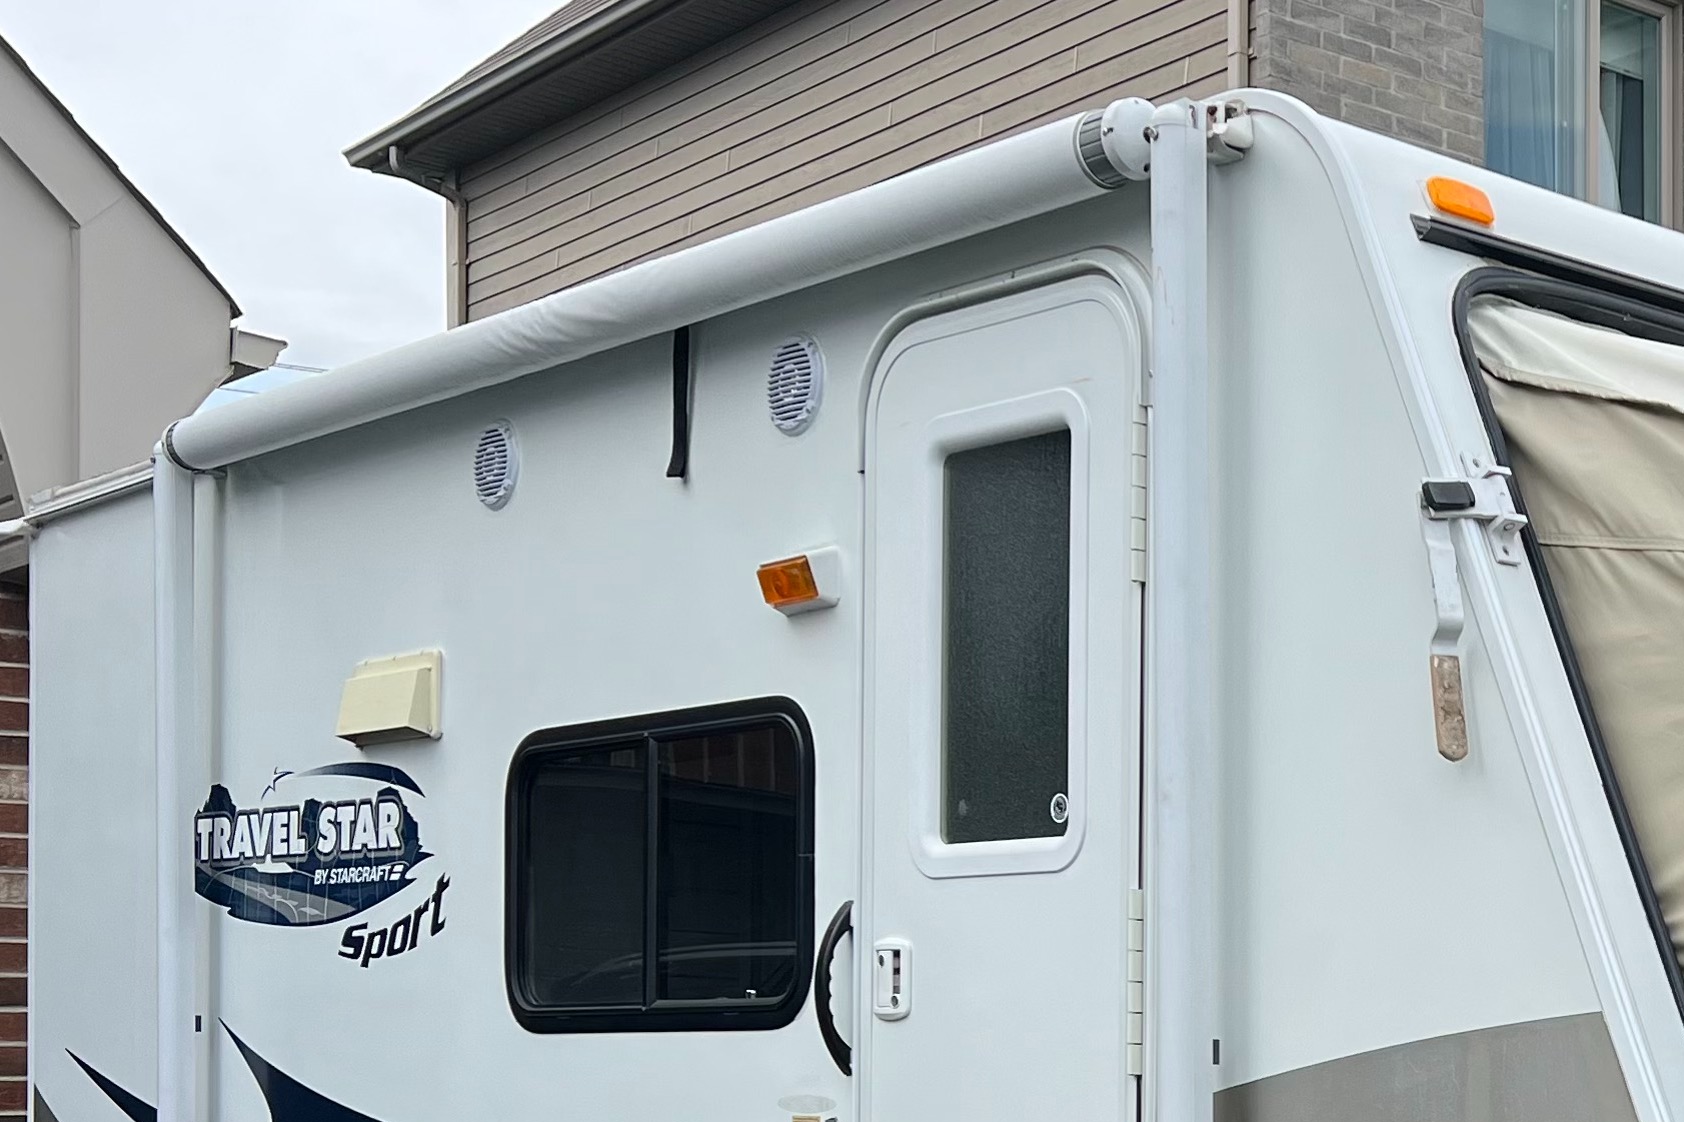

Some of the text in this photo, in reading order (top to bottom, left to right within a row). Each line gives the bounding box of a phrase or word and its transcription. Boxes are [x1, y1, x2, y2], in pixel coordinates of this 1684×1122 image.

[197, 801, 401, 861] TRAVEL STAR
[314, 865, 391, 885] BY STARCRAFT
[338, 873, 451, 968] Sport
